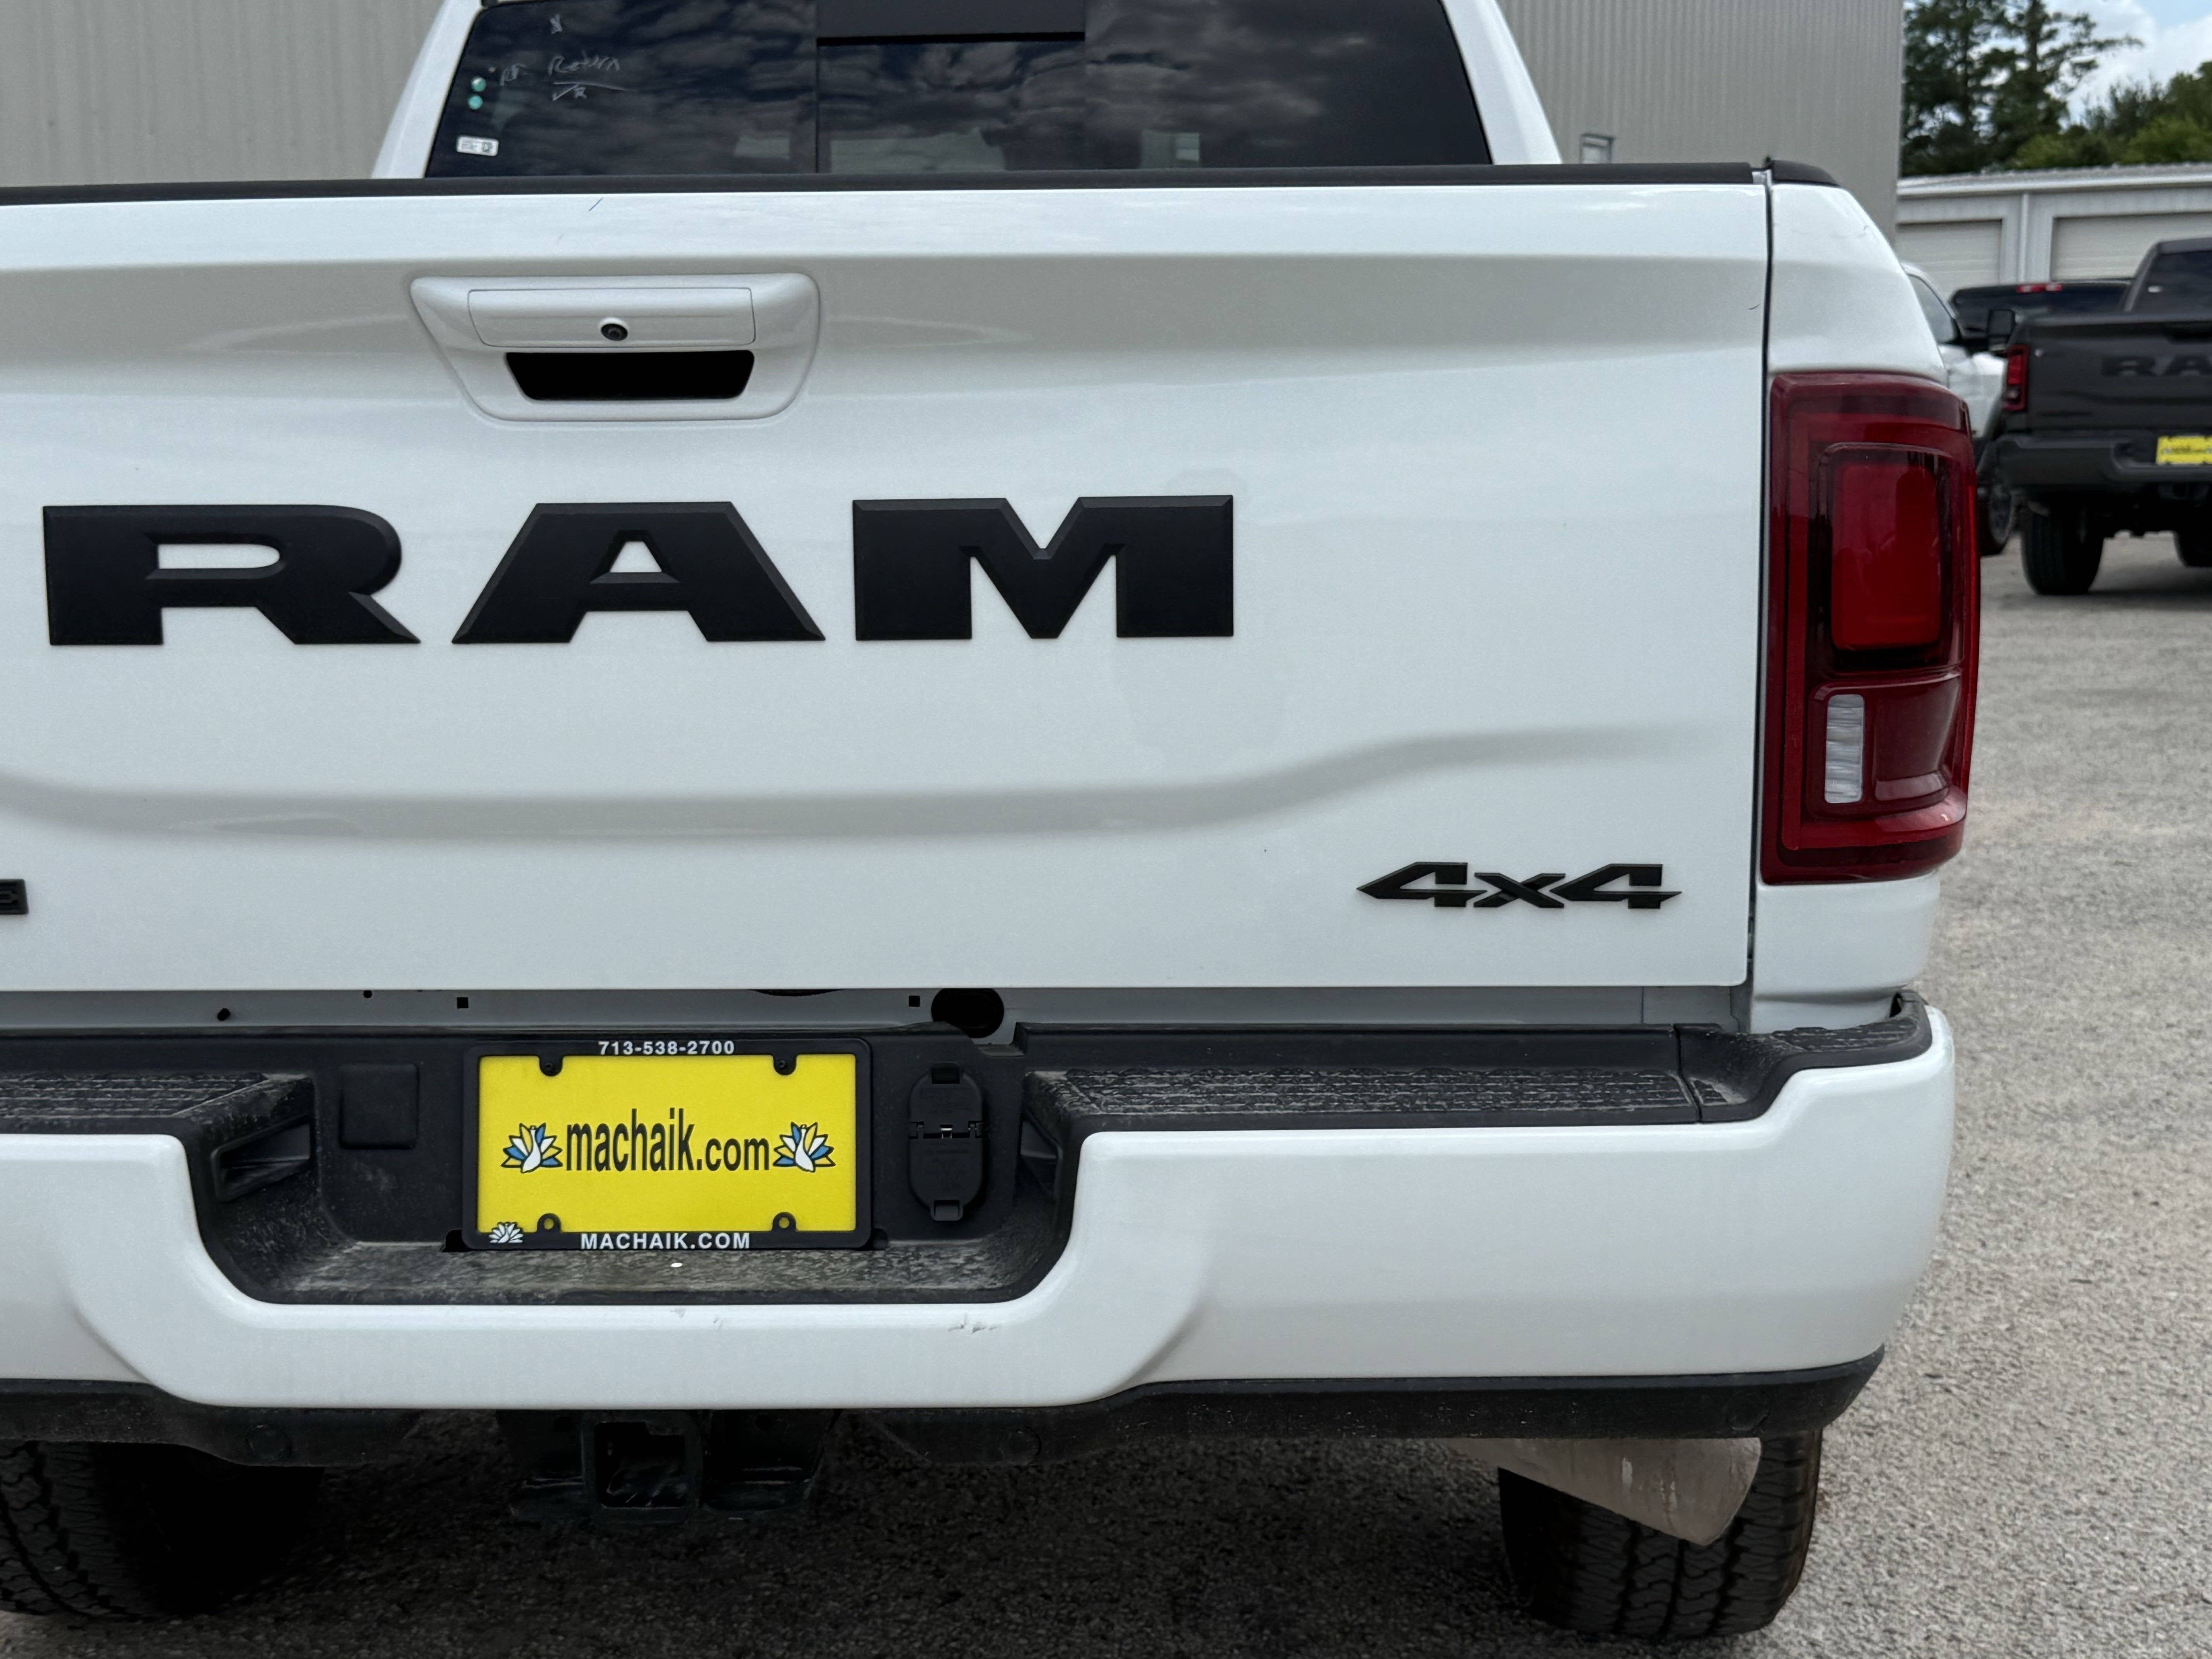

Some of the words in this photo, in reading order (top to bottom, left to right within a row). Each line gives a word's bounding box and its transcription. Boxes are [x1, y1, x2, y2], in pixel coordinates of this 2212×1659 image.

[2100, 355, 2212, 377] RA
[43, 495, 1233, 646] RAM
[1357, 862, 1682, 909] 4x4
[598, 1041, 734, 1055] 713-538-2700
[566, 1108, 769, 1172] machaik.com
[581, 1232, 750, 1249] MACHAIK.COM
